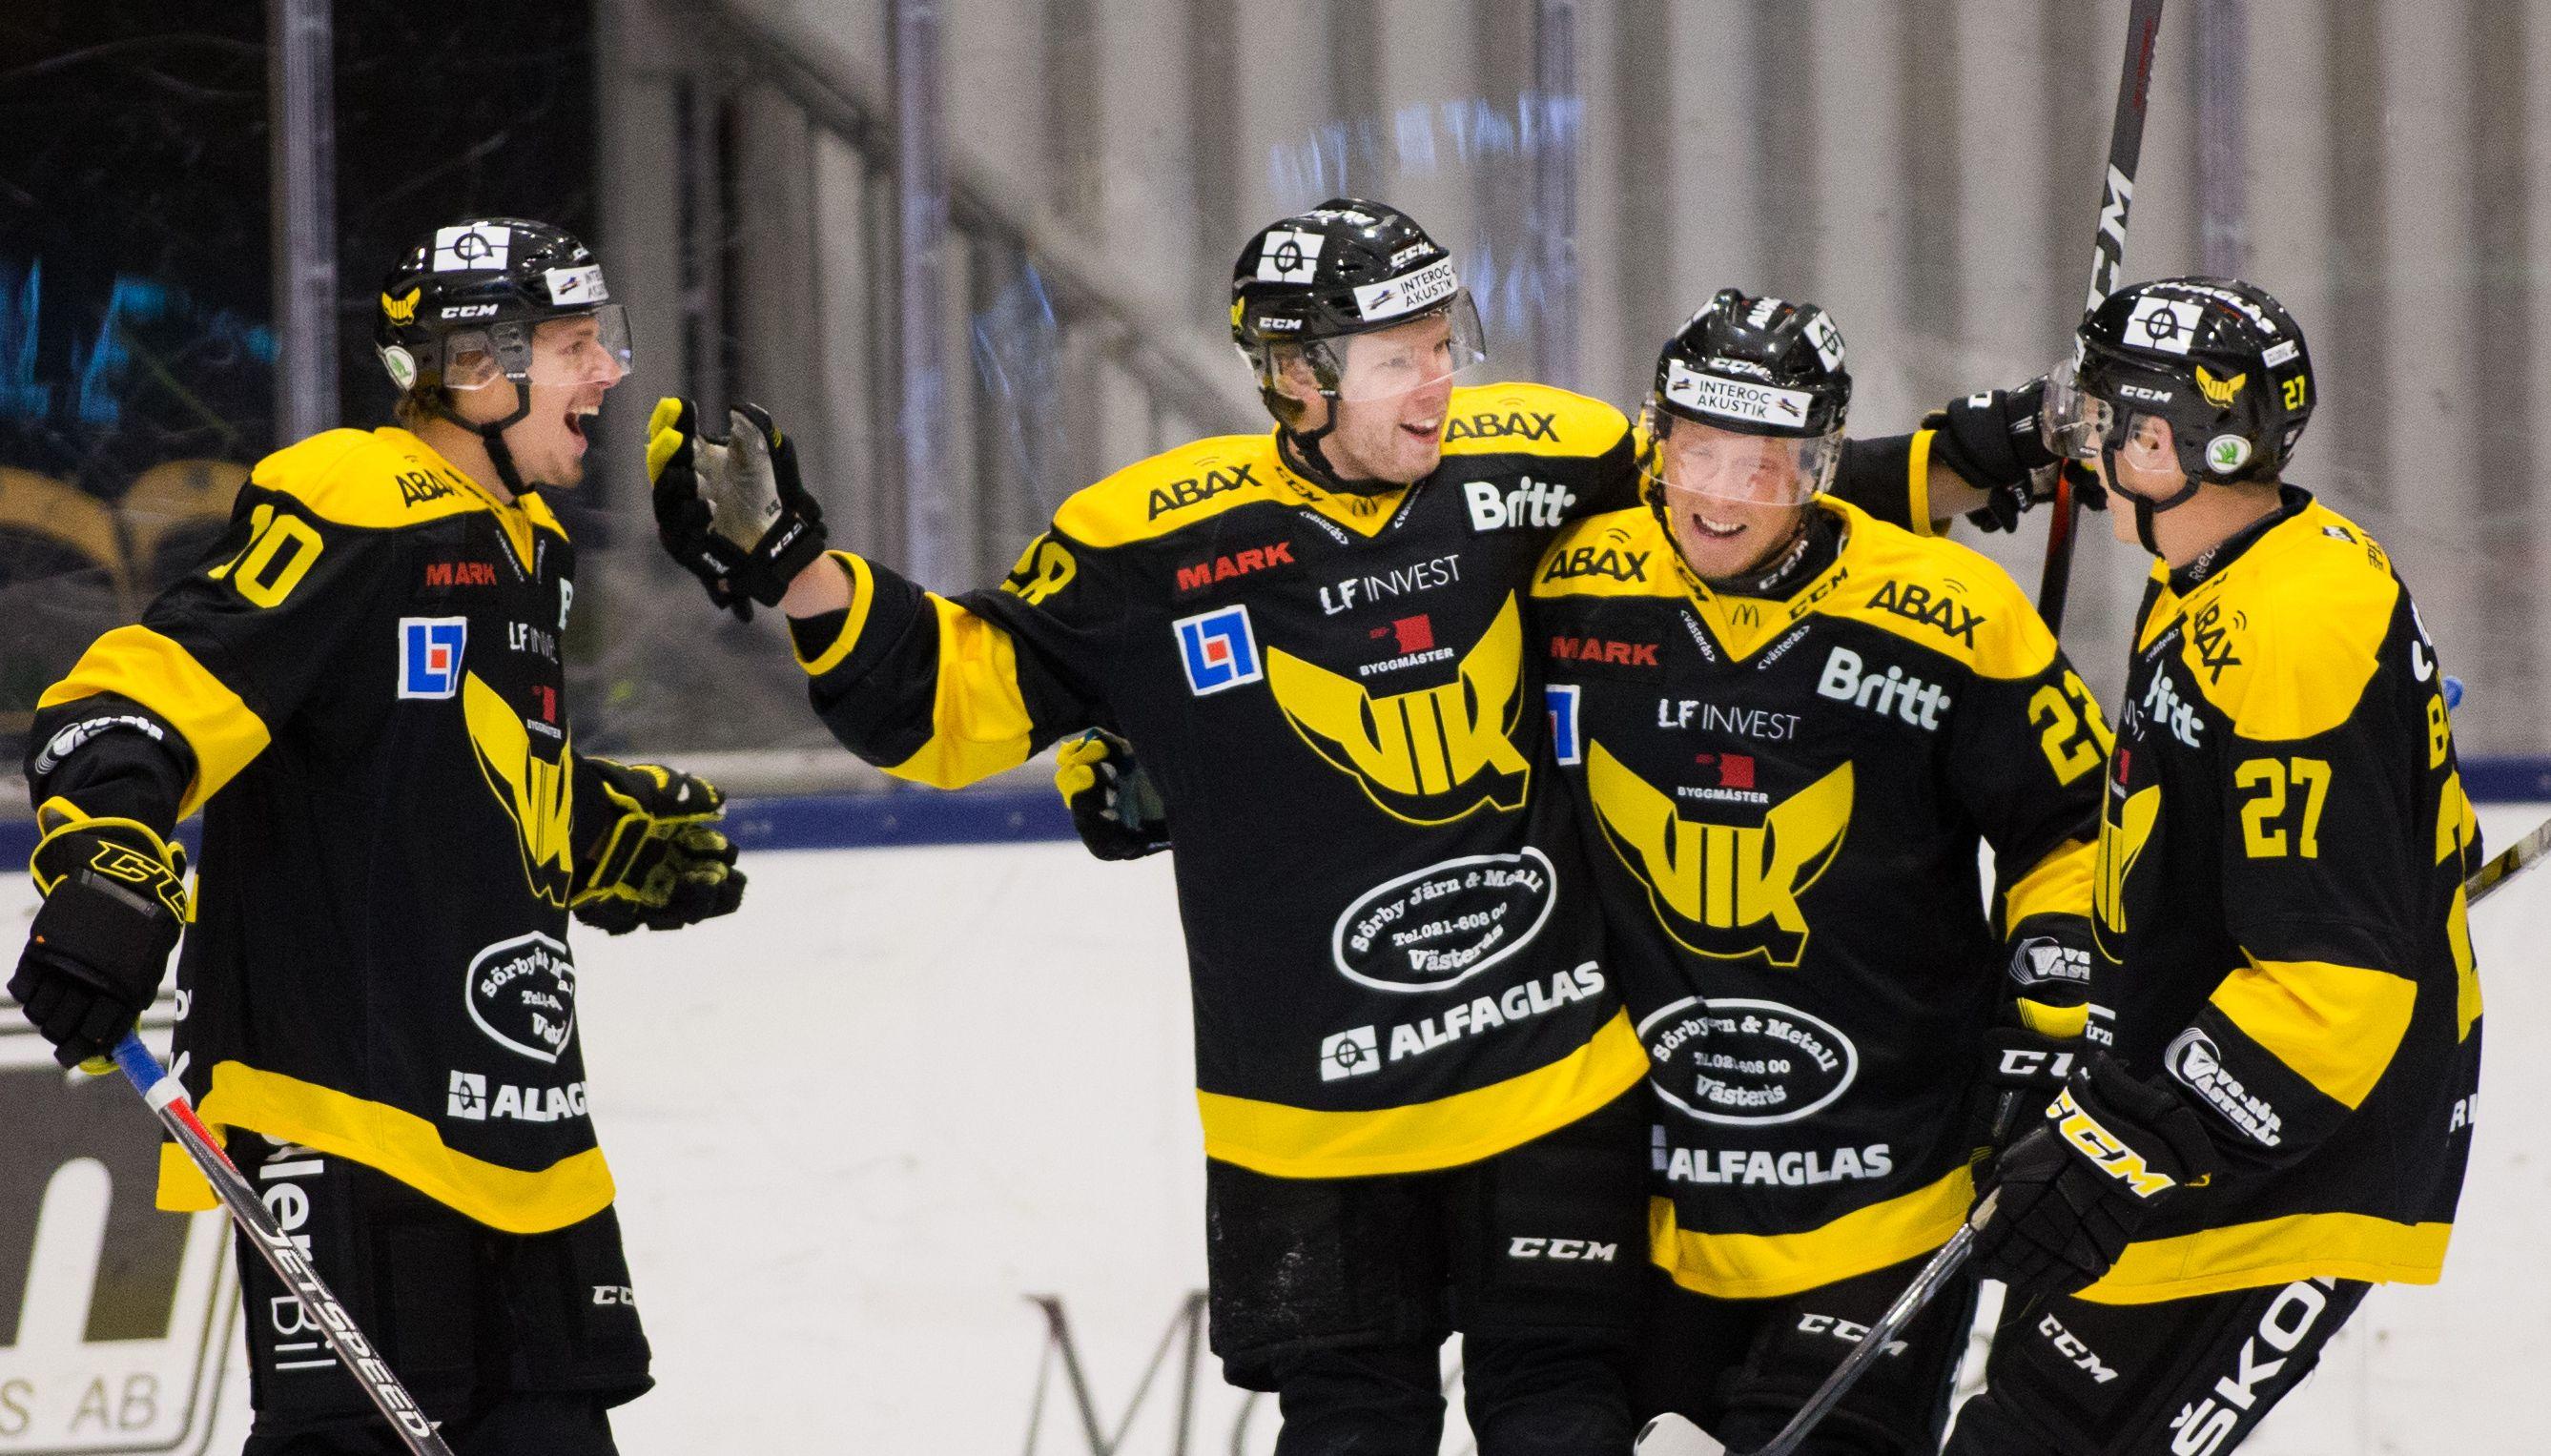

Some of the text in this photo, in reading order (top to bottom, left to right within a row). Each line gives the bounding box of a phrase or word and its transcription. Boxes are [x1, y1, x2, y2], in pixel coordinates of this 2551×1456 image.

[2083, 162, 2134, 318] CM
[1400, 264, 1450, 295] INTEROC
[441, 302, 499, 319] CCM
[1259, 316, 1303, 330] CCM
[1697, 394, 1767, 419] AKUSTIK
[1698, 379, 1773, 405] INTEROC
[2120, 383, 2173, 403] CCM
[2282, 375, 2306, 411] 27
[1445, 411, 1561, 443] ABAX
[1148, 462, 1263, 522] ABAX
[1464, 475, 1577, 532] Britt
[425, 561, 497, 587] MARK
[1176, 541, 1295, 592] MARK
[1319, 554, 1460, 616] LF INVEST
[1541, 546, 1651, 584] ABAX
[1787, 566, 1849, 621] CCM
[1865, 580, 1987, 650] ABAX
[1359, 646, 1455, 677] BYGGMÄSTER
[1550, 635, 1659, 666] MARK
[2193, 601, 2243, 686] BAX
[1817, 646, 1952, 732] Britt
[1657, 698, 1801, 741] LF INVEST
[1677, 785, 1770, 804] BYGGMÄSTER
[2234, 757, 2333, 859] 27
[1350, 901, 1407, 954] Sörby
[1409, 876, 1461, 905] Järn
[1465, 872, 1482, 889] &
[1389, 960, 1606, 1062] ALFAGLAS
[1652, 1015, 1710, 1062] Sörby
[1740, 1015, 1763, 1035] &
[1765, 1017, 1839, 1073] Metall
[1767, 1059, 1791, 1074] 00
[1668, 1143, 1893, 1186] ALFAGLAS
[1508, 1236, 1617, 1261] CCM
[248, 1217, 431, 1438] JETSPEED
[2038, 1312, 2119, 1384] CCM
[2170, 1277, 2337, 1456] ŠKO
[71, 1373, 160, 1433] AB
